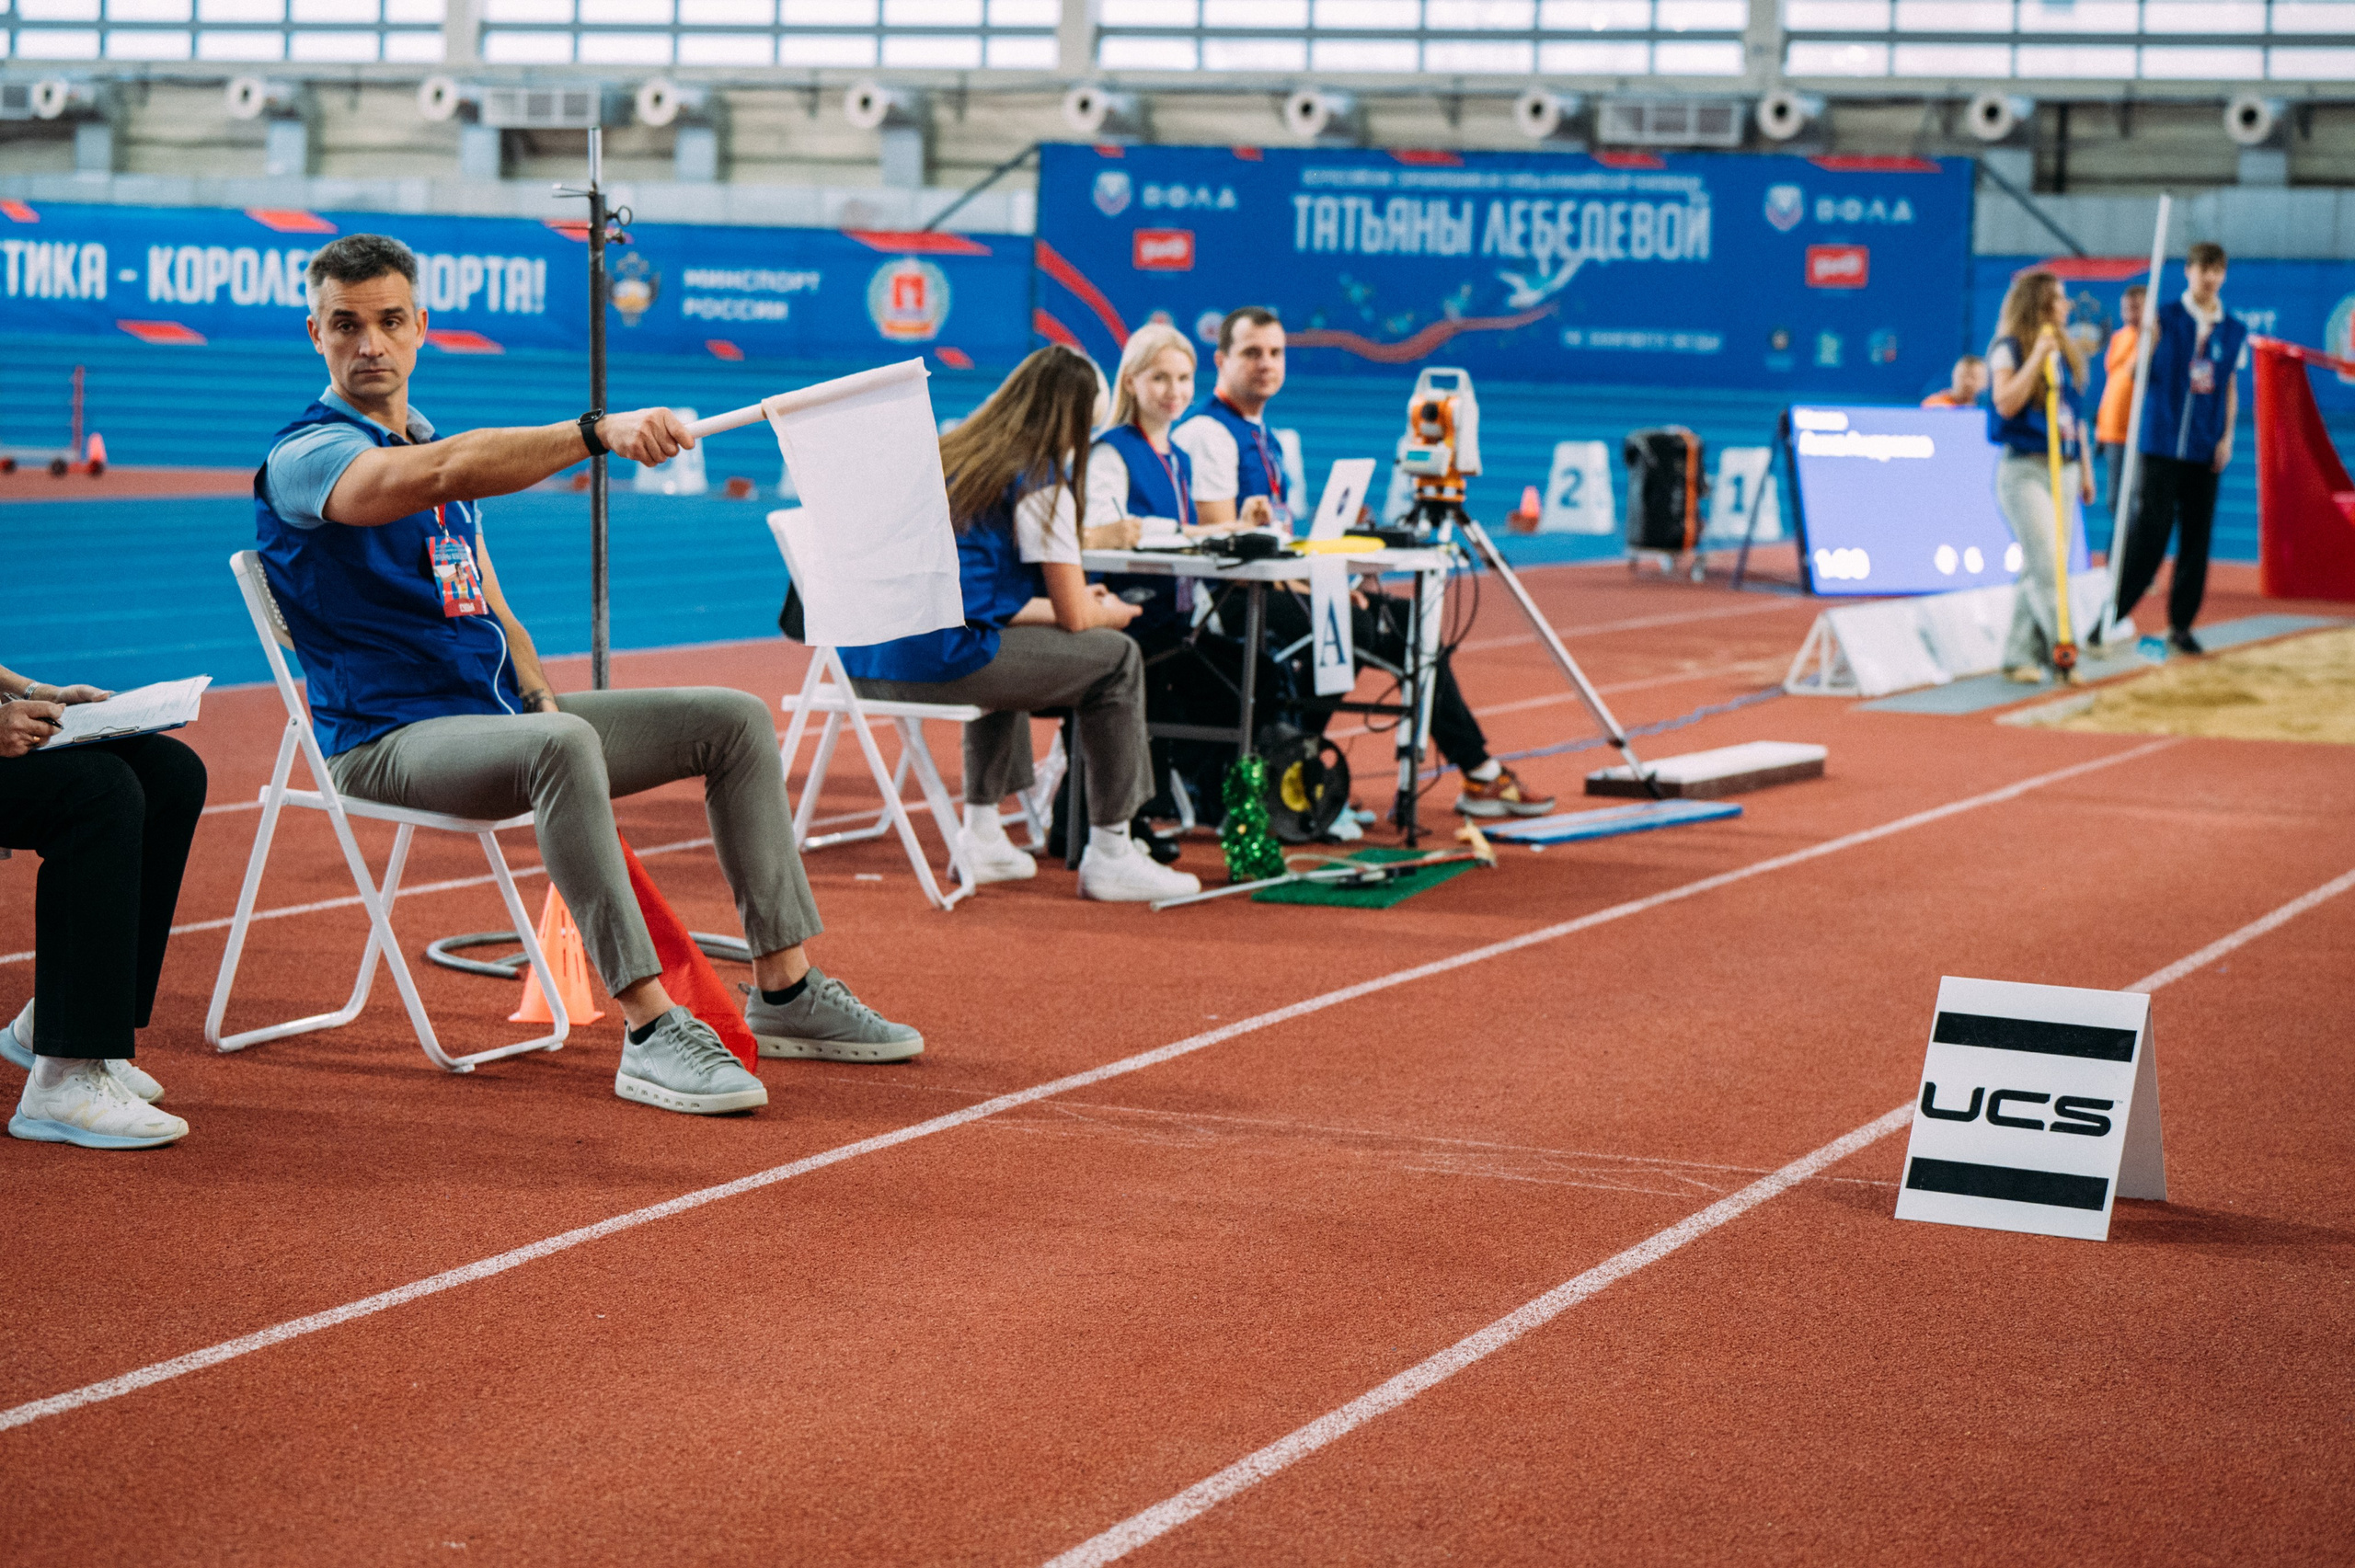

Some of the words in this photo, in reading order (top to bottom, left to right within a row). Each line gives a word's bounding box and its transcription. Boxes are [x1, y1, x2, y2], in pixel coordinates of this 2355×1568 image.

[1293, 194, 1474, 256] ТАТЬЯНЫ
[1482, 189, 1711, 261] ЛЕБЕДЕВОЙ
[1559, 466, 1584, 509] 2
[1920, 1081, 2114, 1138] UCS
